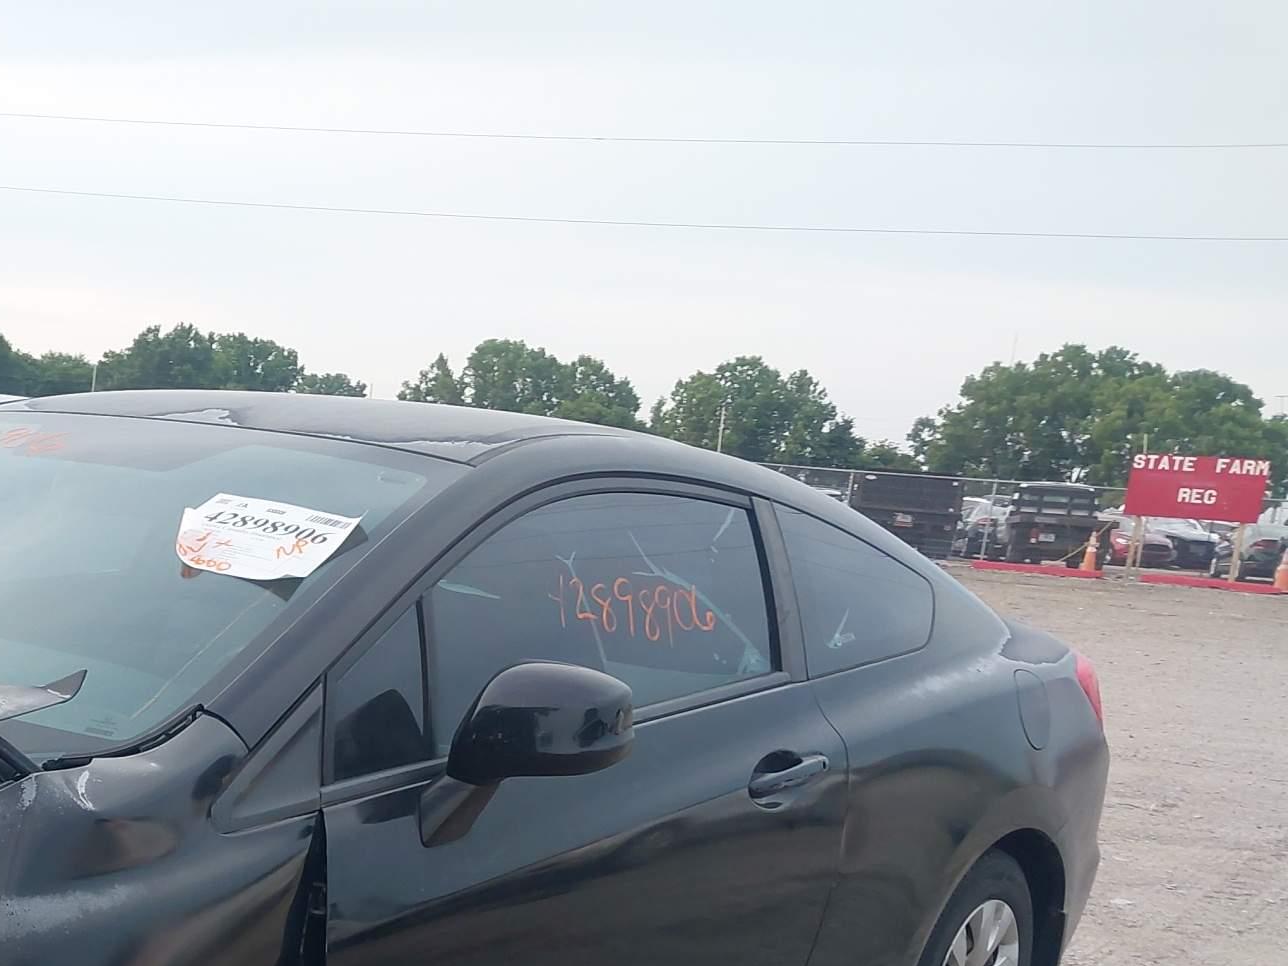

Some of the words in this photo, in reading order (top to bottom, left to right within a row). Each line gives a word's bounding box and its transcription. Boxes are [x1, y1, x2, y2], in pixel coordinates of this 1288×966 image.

[1133, 454, 1198, 472] STATE
[1215, 458, 1272, 476] FARM
[1177, 487, 1218, 505] REG
[204, 510, 336, 545] 42898906
